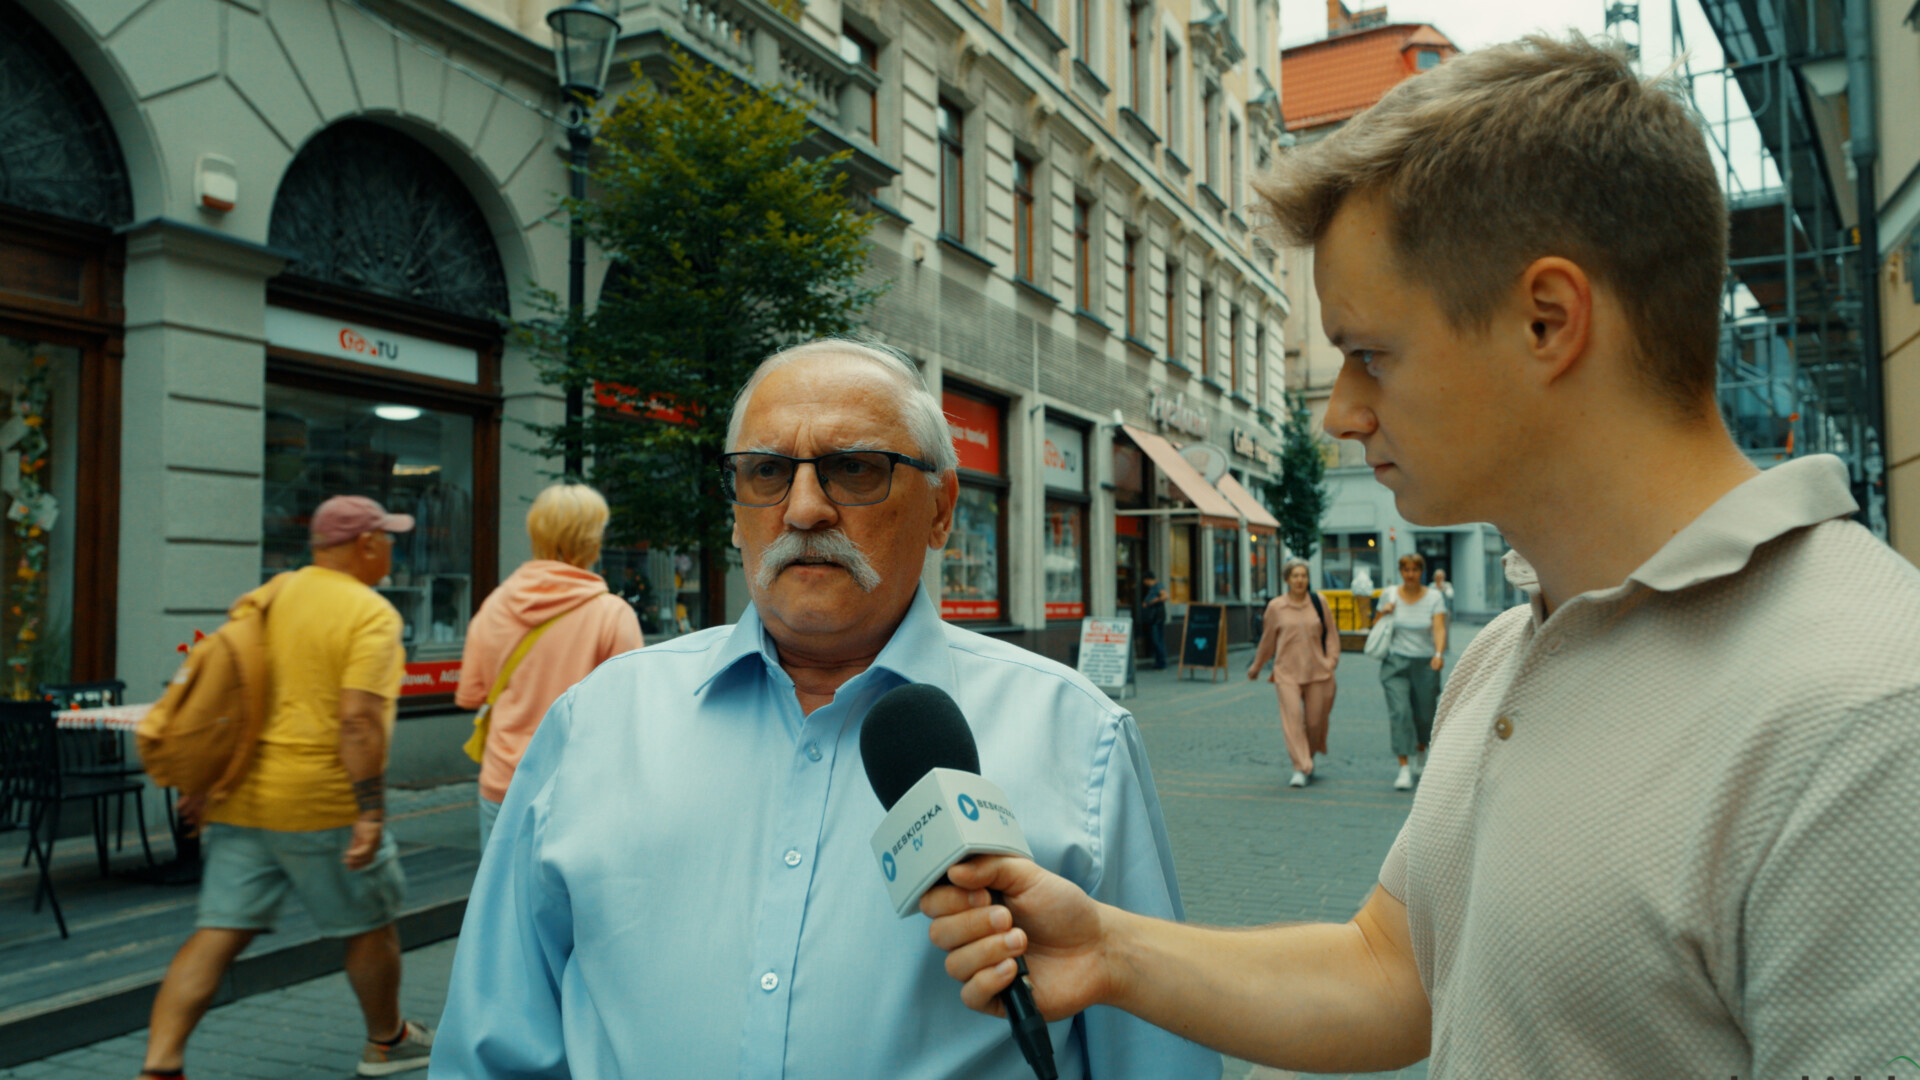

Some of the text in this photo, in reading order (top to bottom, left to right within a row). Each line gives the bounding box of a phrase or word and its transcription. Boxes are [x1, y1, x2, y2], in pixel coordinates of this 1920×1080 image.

[977, 799, 1015, 819] BESKIDZKA
[892, 804, 942, 856] BESKIDZKA
[911, 834, 924, 852] tv
